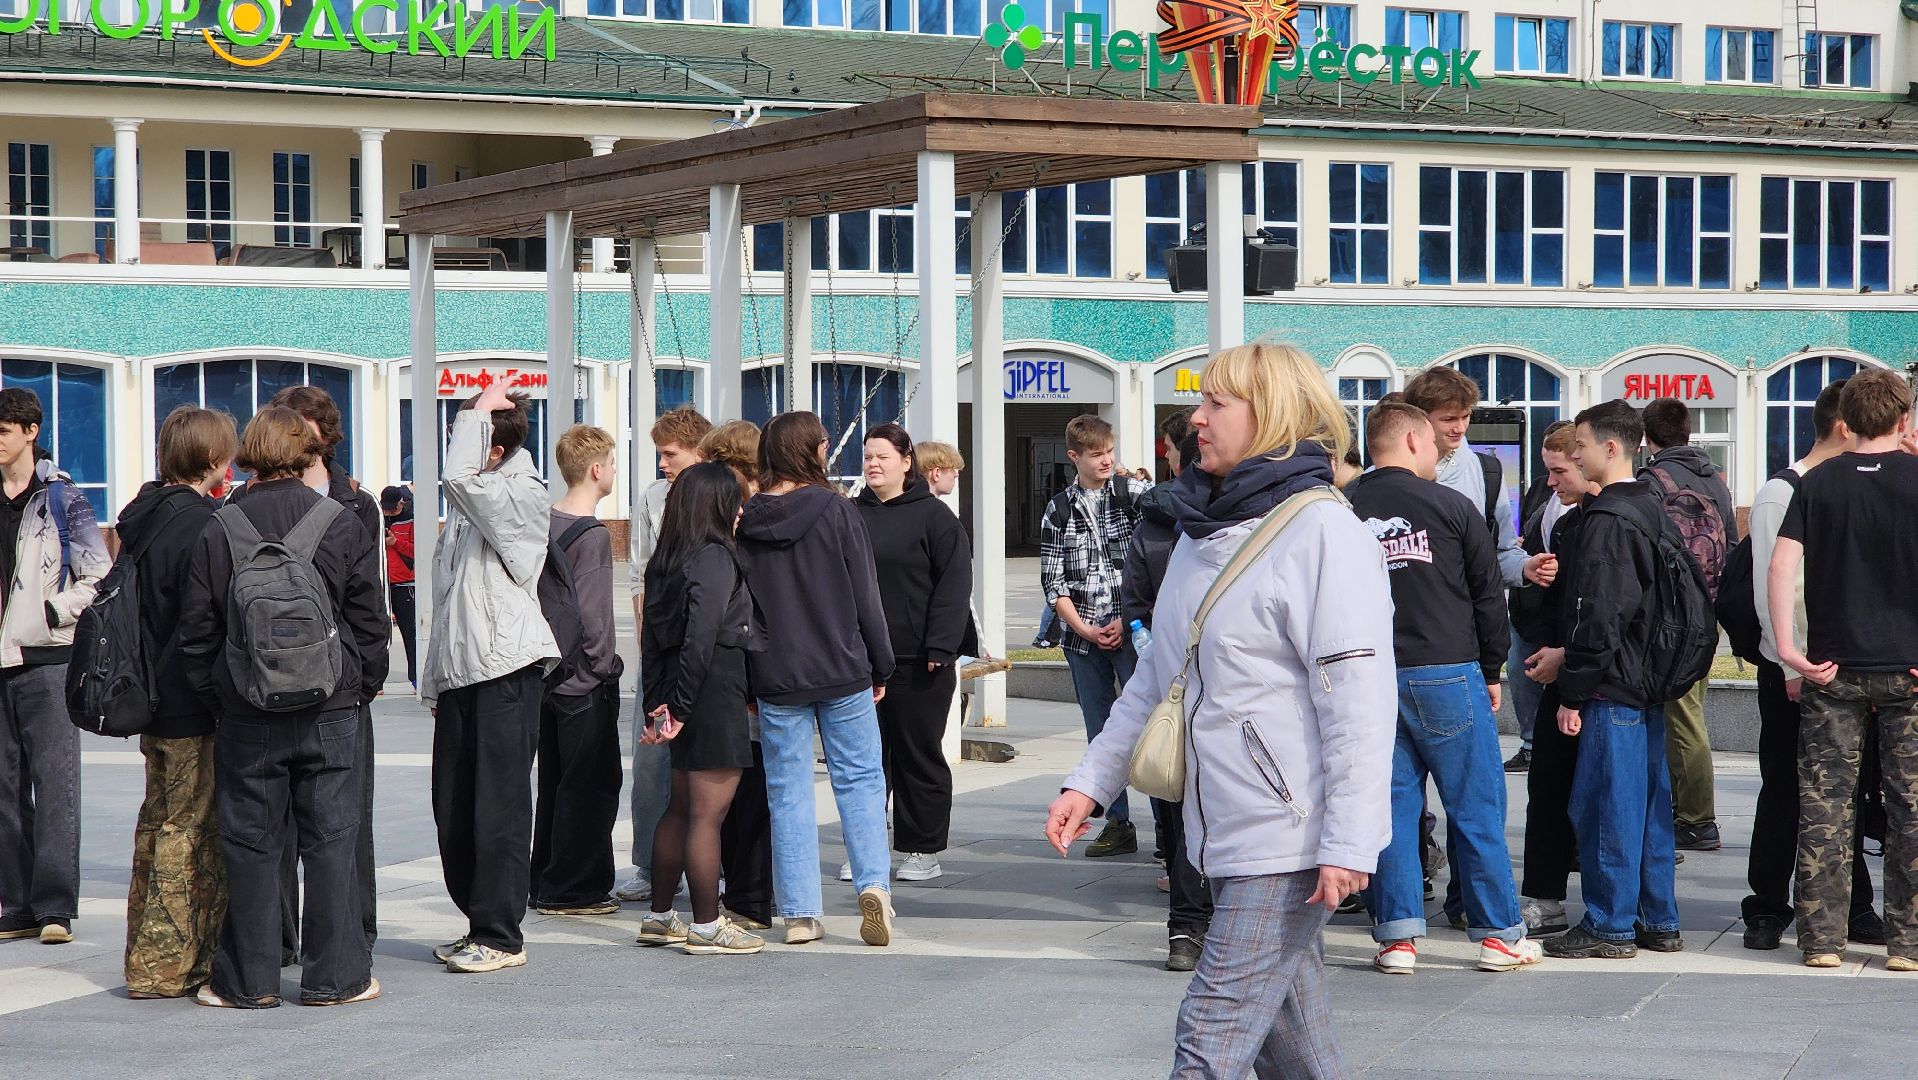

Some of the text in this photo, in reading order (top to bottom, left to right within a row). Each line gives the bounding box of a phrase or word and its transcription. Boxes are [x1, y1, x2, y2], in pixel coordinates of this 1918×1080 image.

[1063, 12, 1481, 95] Перрёсток
[438, 368, 548, 391] АльфБан
[1623, 373, 1716, 400] ЯНИТА
[1380, 529, 1430, 558] SDALE
[1388, 561, 1409, 571] NDON
